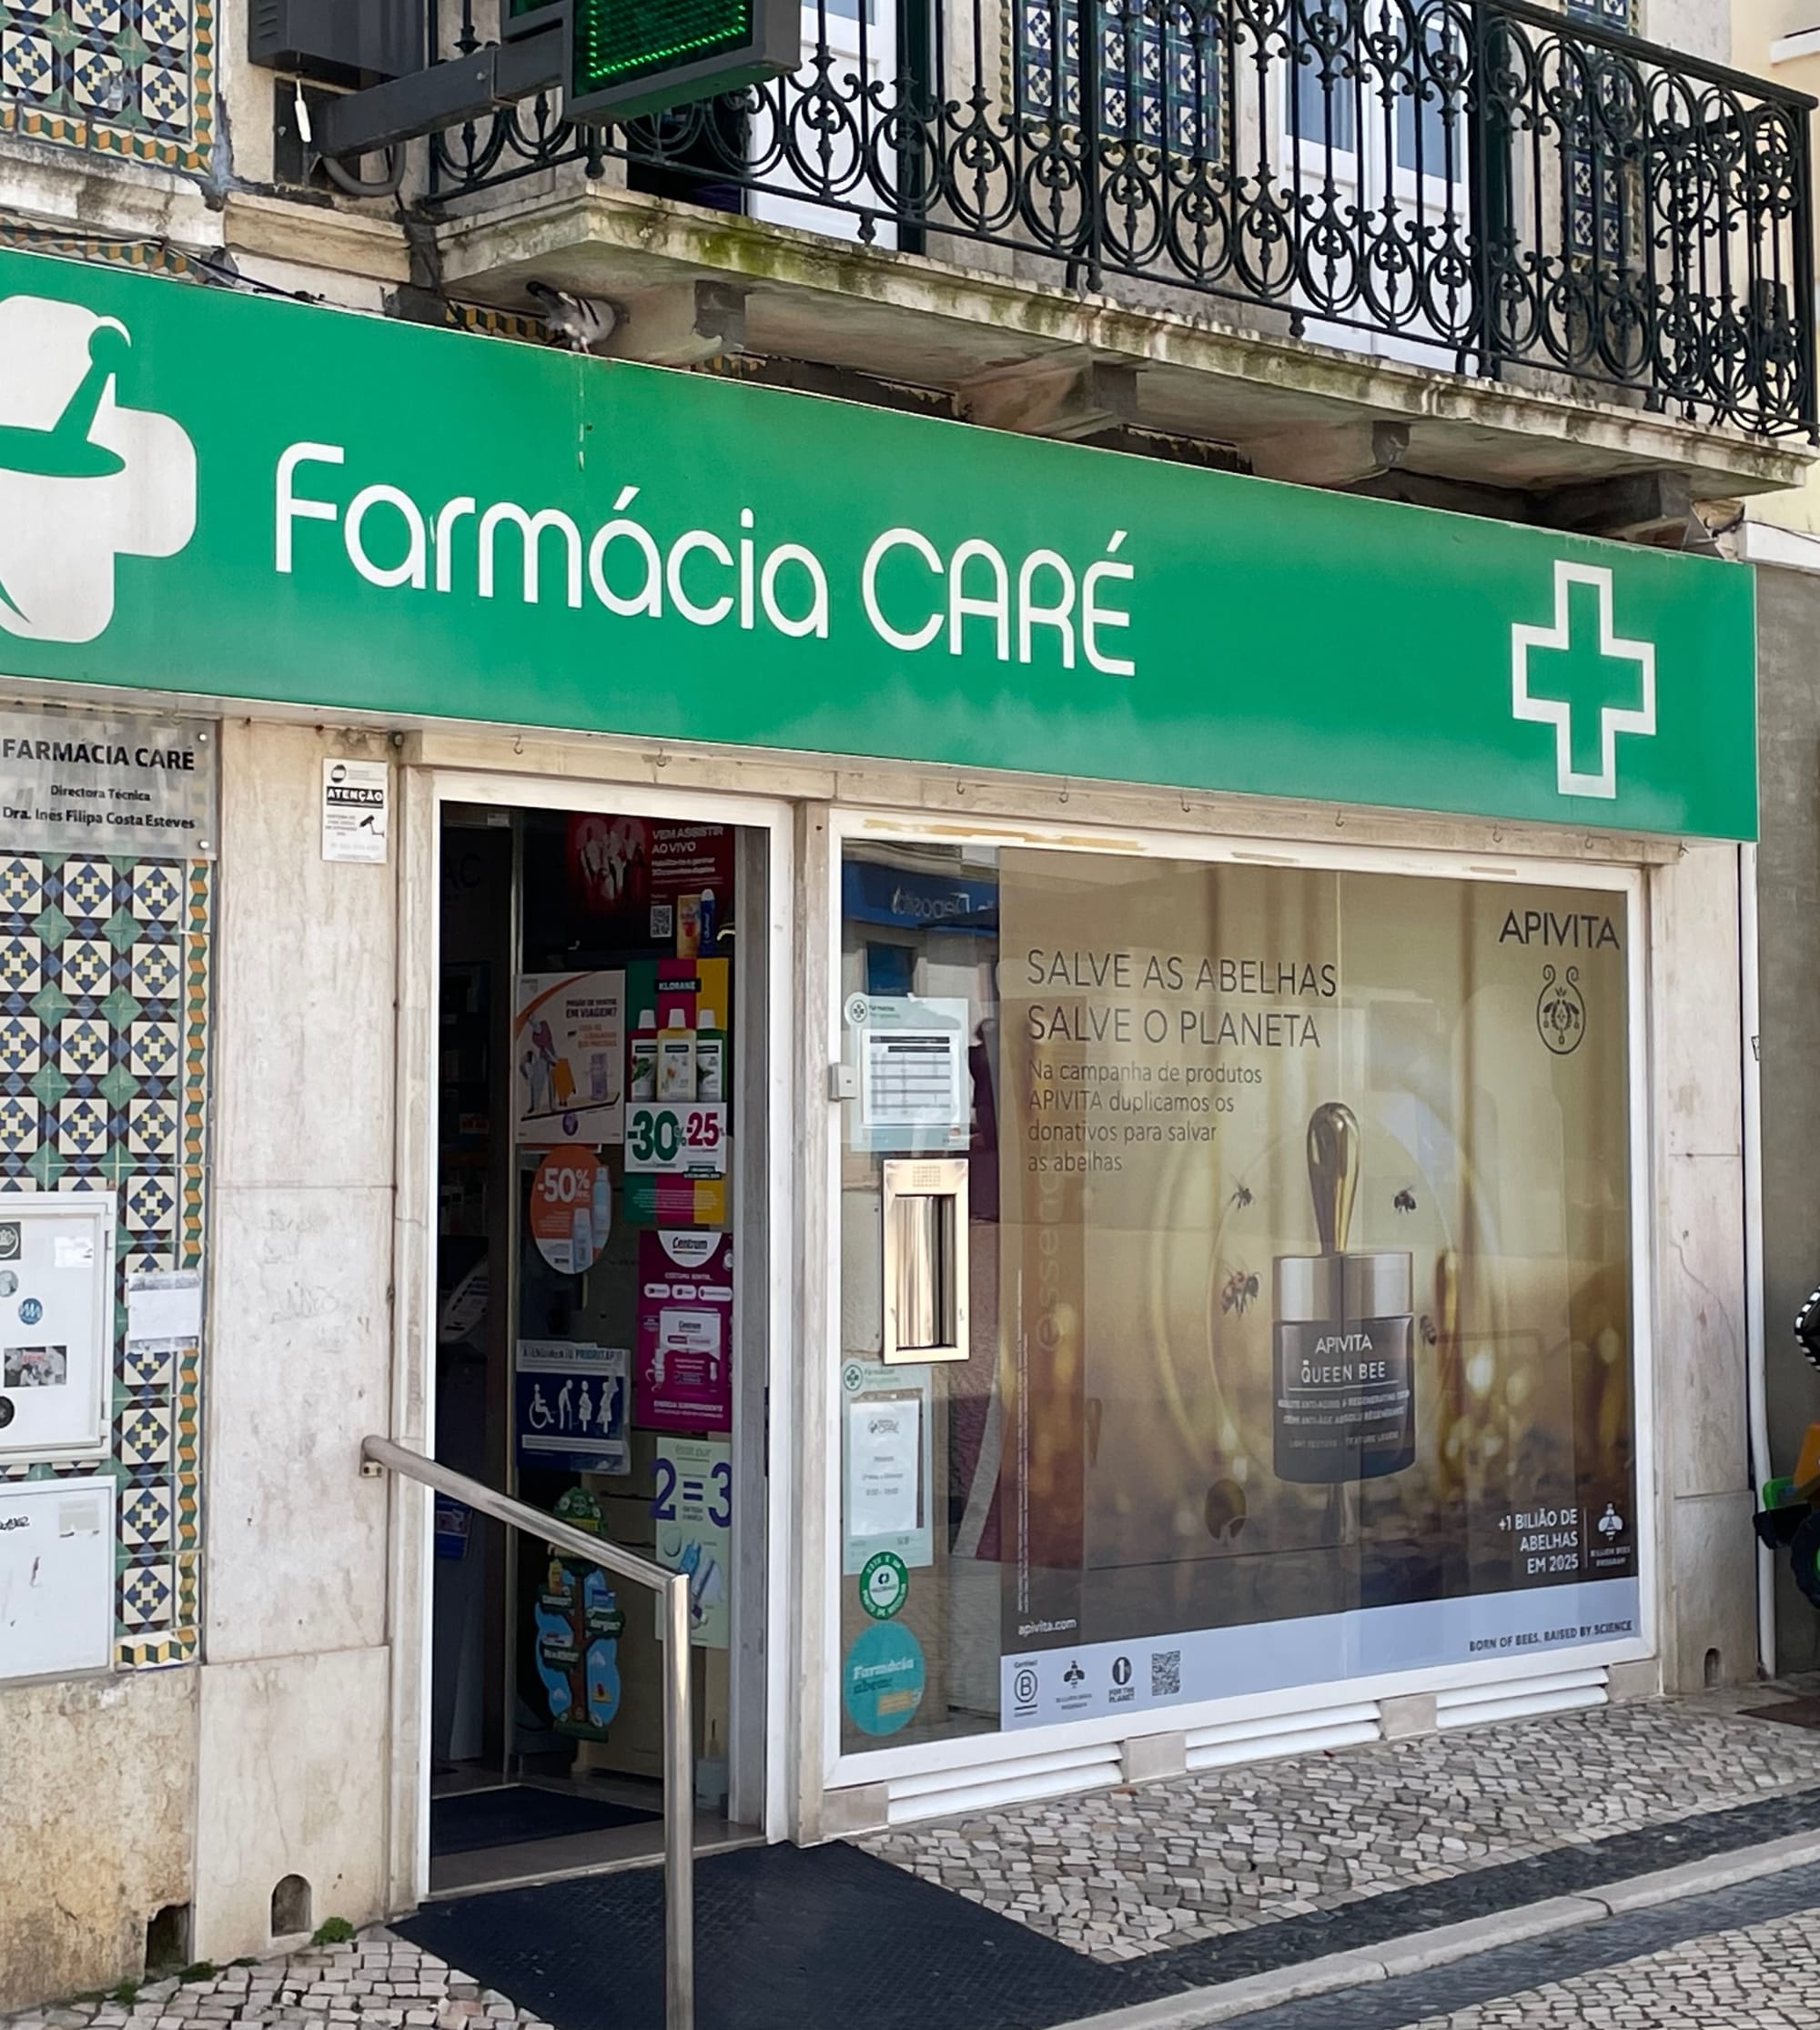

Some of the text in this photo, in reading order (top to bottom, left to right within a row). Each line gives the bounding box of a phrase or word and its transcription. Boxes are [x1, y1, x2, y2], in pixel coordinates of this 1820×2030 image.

[276, 442, 1136, 676] Farmácia CARÉ
[3, 738, 195, 772] FARMÁCIA CARÉ
[51, 783, 151, 802] Directora Técnica
[328, 788, 383, 802] ATENÇÃO
[3, 806, 196, 830] Dra. Inês Filipa Costa Esteves
[669, 841, 697, 853] VIVO
[1499, 909, 1620, 950] APIVITA
[1026, 949, 1338, 997] SALVE AS ABELHAS
[1027, 1005, 1320, 1048] SALVE O PLANETA
[1029, 1060, 1262, 1089] Na campanha de produtos
[1028, 1090, 1234, 1116] APIVITA duplicamos os
[627, 1109, 686, 1162] -30%
[1028, 1120, 1217, 1145] donativos para salvar
[1028, 1151, 1123, 1172] as abelhas
[537, 1166, 591, 1203] -50%
[672, 1237, 708, 1250] Centrum
[1314, 1334, 1373, 1354] APIVITA
[1300, 1361, 1386, 1383] QUEEN BEE
[1499, 1508, 1578, 1531] +1 BILIÃO DE
[1520, 1531, 1578, 1552] ABELHAS
[1527, 1554, 1579, 1574] EM 2025
[1017, 1618, 1077, 1637] apivita.com
[1470, 1638, 1497, 1651] BORN
[1500, 1636, 1512, 1647] OF
[1544, 1627, 1577, 1641] RAISED
[1580, 1626, 1592, 1637] BY
[1594, 1620, 1633, 1635] SCIENCE
[852, 1656, 915, 1681] Farmácia
